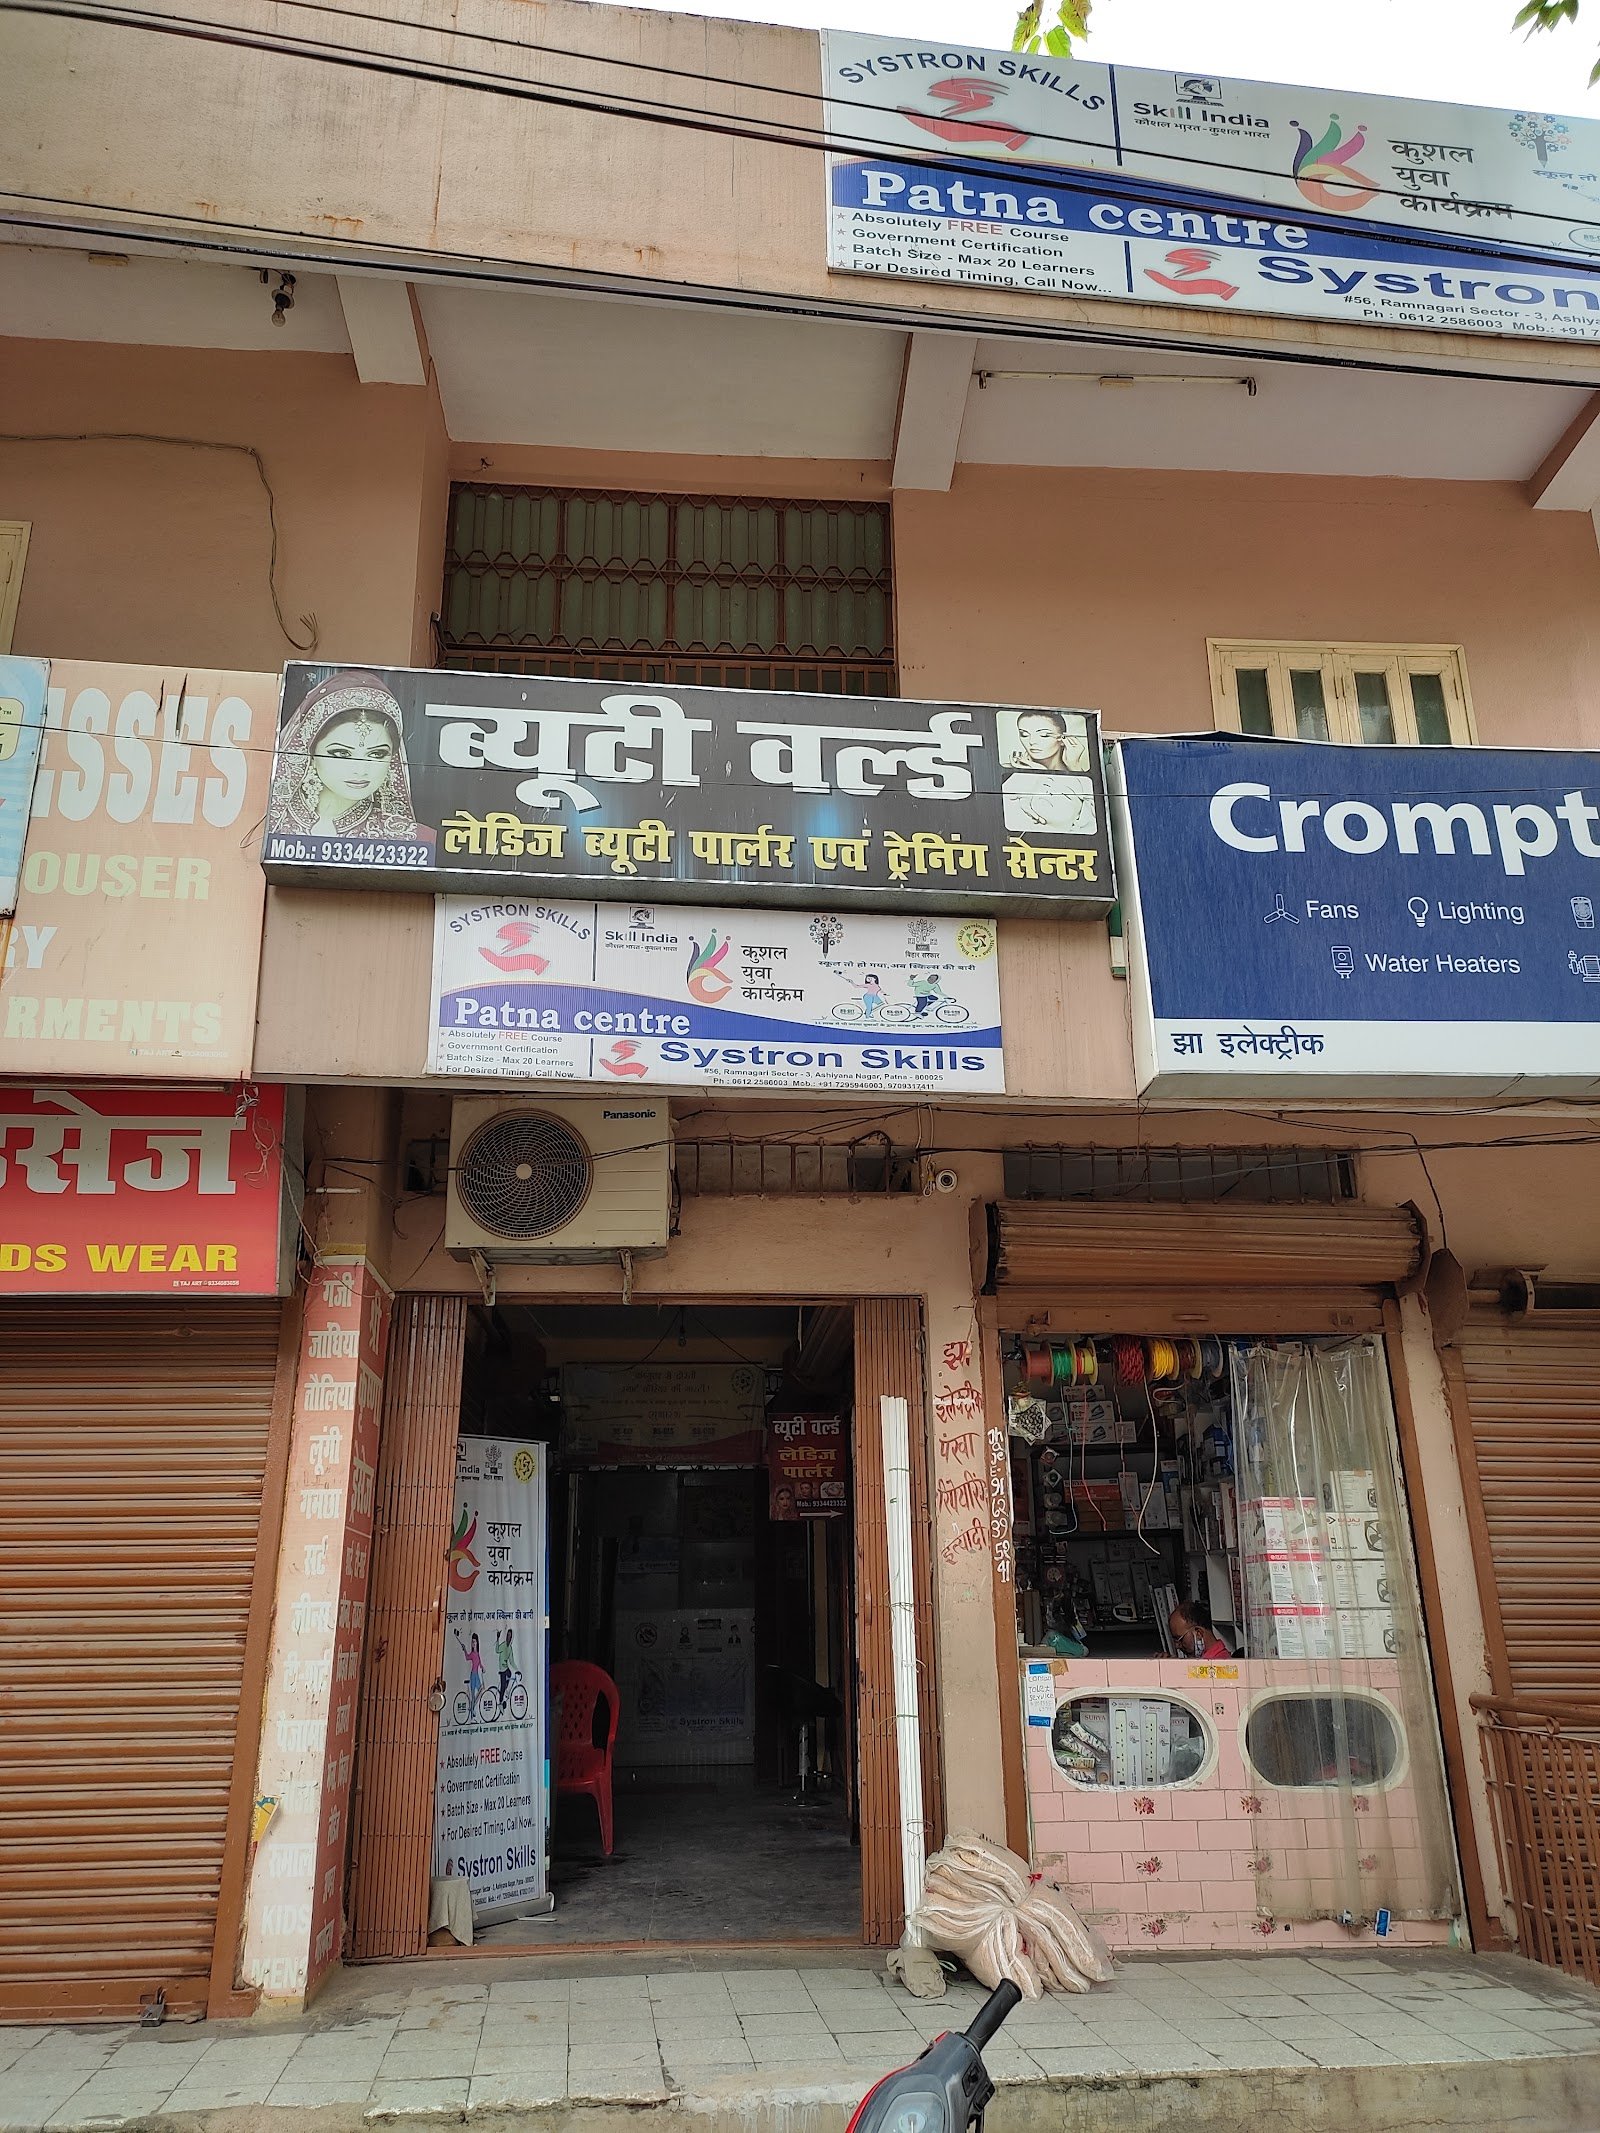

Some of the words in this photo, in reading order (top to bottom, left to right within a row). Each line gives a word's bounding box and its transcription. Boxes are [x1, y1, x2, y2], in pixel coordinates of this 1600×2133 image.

[839, 52, 986, 84] SYSTRON
[998, 60, 1106, 112] SKILLS
[1133, 102, 1191, 120] Skill
[1202, 110, 1269, 128] India
[1134, 117, 1170, 128] कौशल
[1174, 123, 1200, 132] भारत
[1209, 127, 1240, 136] कुशल
[1242, 130, 1271, 139] भारत
[1387, 139, 1474, 165] कुशल
[1393, 166, 1450, 192] युवा
[861, 169, 1064, 226] Patna
[1088, 203, 1309, 249] centre
[1400, 190, 1513, 220] कार्यक्रम
[851, 211, 941, 231] Absolutely
[947, 219, 1003, 236] FREE
[1010, 227, 1069, 243] Course
[852, 228, 956, 247] Government
[961, 236, 1063, 257] Certification
[853, 243, 902, 259] Batch
[907, 248, 942, 261] Size
[958, 253, 992, 267] Max
[998, 256, 1016, 269] 20
[1022, 259, 1095, 276] Learners
[853, 259, 881, 272] For
[887, 262, 951, 278] Desired
[957, 269, 1019, 286] Timing,
[1024, 275, 1056, 288] Call
[1061, 280, 1112, 294] Now...
[1259, 255, 1600, 311] Systron
[1344, 295, 1375, 307] #56,
[1381, 298, 1465, 314] Ramnagari
[1470, 306, 1519, 318] Sector
[1534, 311, 1548, 323] 3,
[1363, 308, 1384, 318] Ph
[1399, 312, 1435, 323] 0612
[1440, 316, 1503, 329] 2586003
[1512, 321, 1555, 333] Mob.:
[1559, 326, 1586, 337] +91
[424, 694, 712, 815] ब्यूटी
[737, 710, 984, 801] वर्ल्ड
[1209, 782, 1600, 875] Crompt
[270, 839, 316, 859] Mob.:
[321, 842, 428, 865] 9334423322
[442, 813, 566, 862] लेडिज
[583, 818, 673, 876] ब्यूटी
[688, 824, 795, 870] पार्लर
[807, 829, 872, 874] एवं
[884, 831, 991, 882] ट्रेनिंग
[1003, 839, 1098, 884] सेन्टर
[24, 851, 211, 900] OUSER
[449, 904, 529, 934] SYSTRON
[535, 906, 591, 941] SKILLS
[1306, 900, 1359, 919] Fans
[1438, 900, 1525, 924] Lighting
[605, 930, 636, 942] Skill
[641, 932, 678, 944] India
[740, 944, 787, 964] कुशल
[818, 960, 840, 968] स्कूल
[905, 951, 920, 959] बिहार
[921, 951, 940, 959] सरकार
[1364, 952, 1429, 973] Water
[1435, 953, 1520, 974] Heaters
[741, 966, 772, 985] युवा
[740, 984, 804, 1004] कार्यक्रम
[454, 997, 561, 1030] Patna
[573, 1007, 691, 1035] centre
[447, 1042, 502, 1052] Government
[505, 1044, 558, 1054] Certification
[448, 1030, 496, 1041] Absolutely
[498, 1032, 528, 1041] FREE
[531, 1034, 563, 1042] Course
[1170, 1032, 1204, 1054] झा
[1217, 1025, 1325, 1061] इलेक्ट्रीक
[446, 1054, 473, 1062] Batch
[475, 1054, 494, 1063] Size
[523, 1057, 532, 1065] 20
[535, 1058, 574, 1067] Learners
[660, 1042, 842, 1068] Systron
[861, 1048, 986, 1071] Skills
[464, 1066, 498, 1075] Desired
[501, 1067, 533, 1078] Timing,
[555, 1071, 581, 1079] Now...
[723, 1069, 769, 1079] Ramnagari
[771, 1070, 799, 1078] Sector
[815, 1071, 853, 1081] Ashiyana
[856, 1073, 882, 1081] Nagar,
[792, 1080, 815, 1088] Mob.:
[817, 1081, 833, 1089] +91
[603, 1109, 656, 1119] Panasonic
[0, 1089, 247, 1194] सेज
[86, 1244, 237, 1273] WEAR
[304, 1373, 356, 1411] तौलिया
[773, 1417, 806, 1441] ब्यूटी
[809, 1416, 841, 1436] वर्ल्ड
[778, 1446, 836, 1461] लेडिज
[458, 1464, 480, 1474] India
[783, 1464, 834, 1478] पार्लर
[300, 1488, 342, 1520] गमछा
[487, 1522, 522, 1542] कुशल
[487, 1546, 511, 1567] युवा
[487, 1565, 534, 1587] कार्यक्रम
[447, 1752, 478, 1769] Absolutely
[480, 1748, 500, 1764] FREE
[502, 1750, 523, 1762] Course
[447, 1777, 484, 1793] Government
[485, 1772, 520, 1788] Certification
[447, 1803, 465, 1817] Batch
[466, 1800, 479, 1815] Size
[484, 1797, 497, 1812] Max
[498, 1797, 505, 1810] 20
[506, 1794, 531, 1808] Learners
[447, 1828, 458, 1841] For
[459, 1824, 482, 1840] Desired
[484, 1820, 506, 1836] Timing,
[507, 1818, 518, 1832] Call
[457, 1853, 502, 1879] Systron
[507, 1844, 536, 1871] Skills
